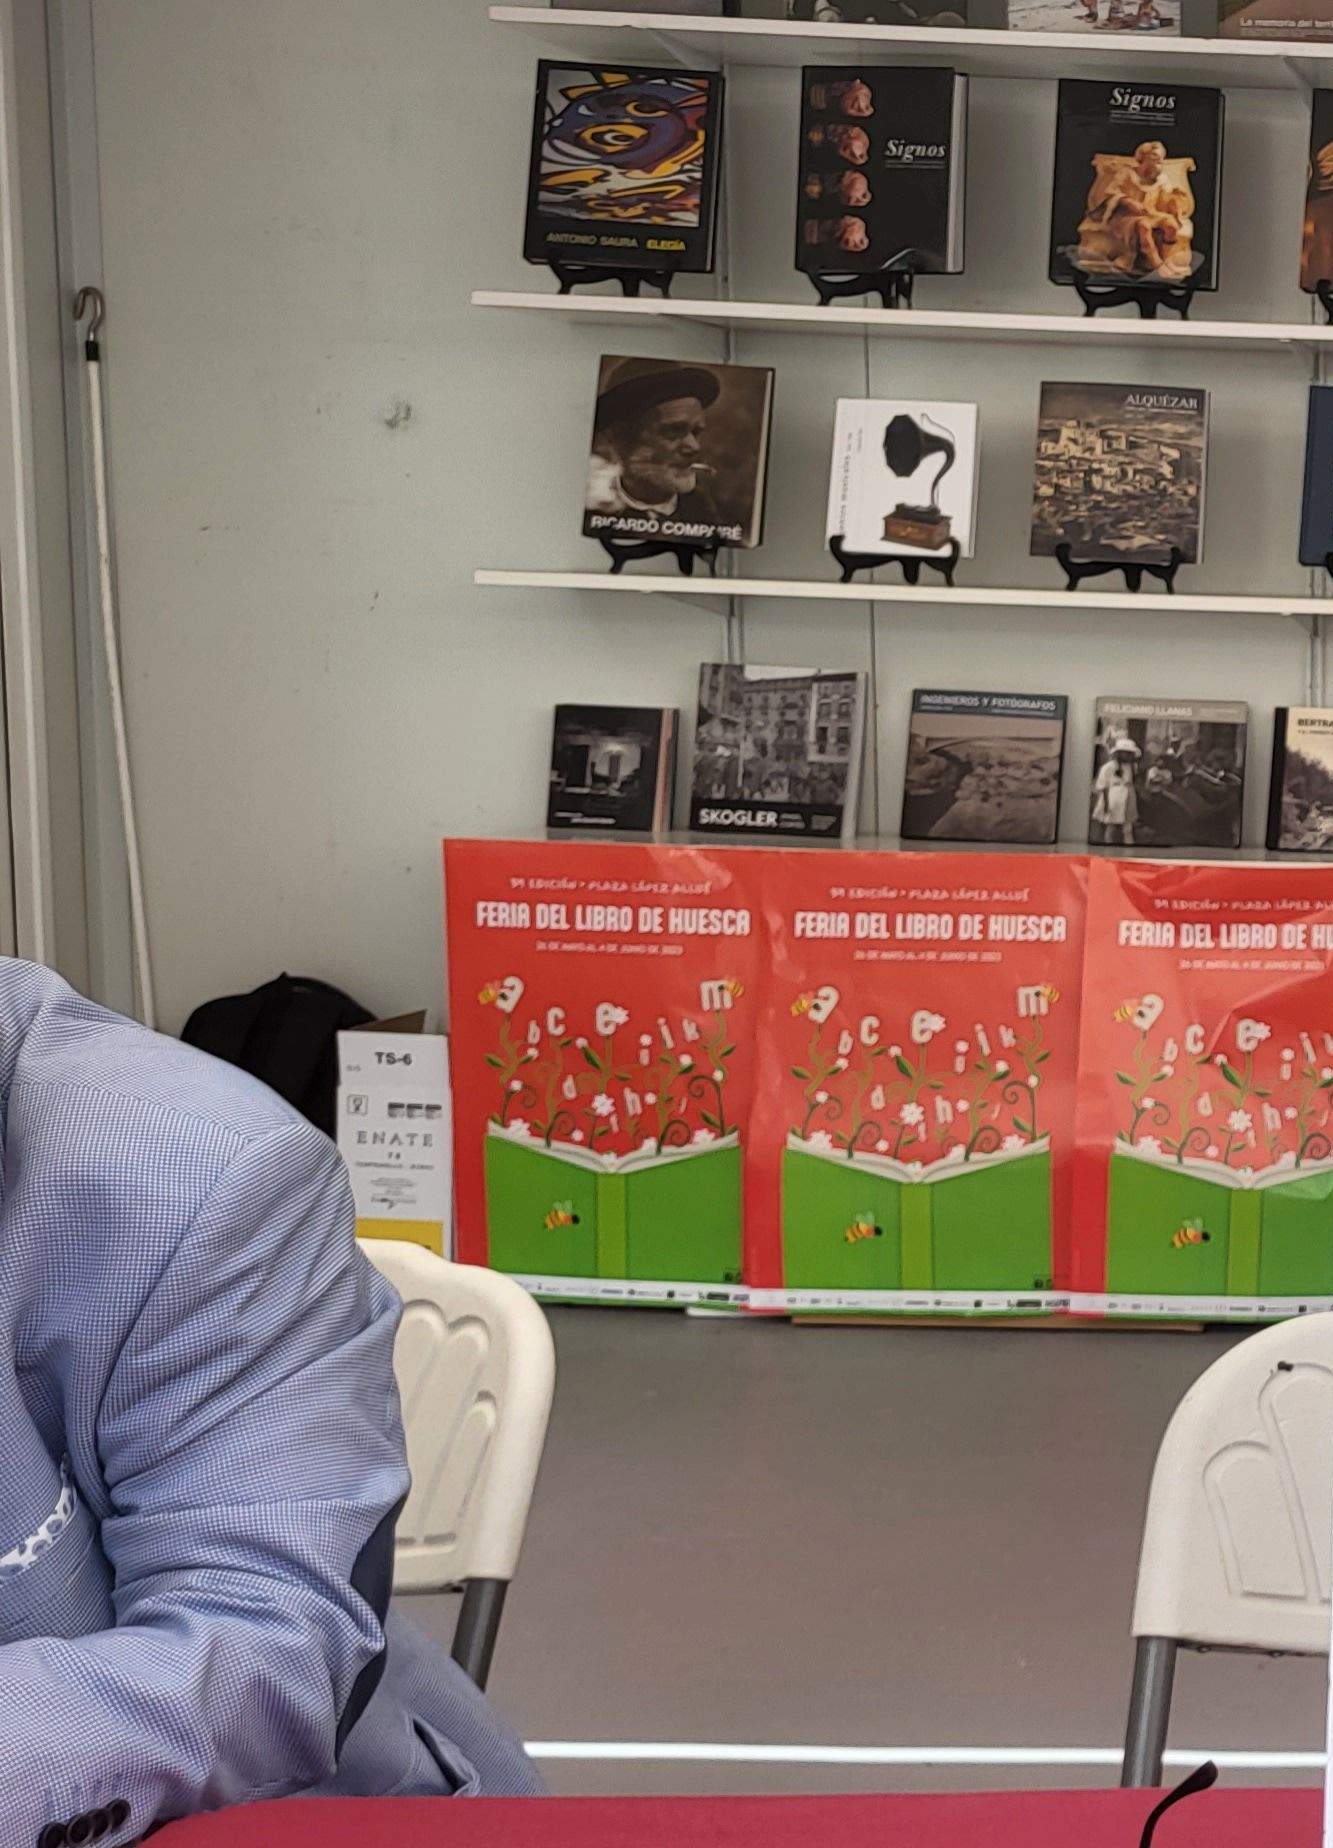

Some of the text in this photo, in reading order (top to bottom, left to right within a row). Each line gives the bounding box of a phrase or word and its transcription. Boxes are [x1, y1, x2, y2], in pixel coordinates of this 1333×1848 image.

[1109, 88, 1177, 113] Signos
[884, 139, 946, 163] Signos
[547, 232, 598, 246] ANTONIO
[600, 235, 639, 248] SAURA
[1125, 392, 1199, 410] ALQUÉZAR
[590, 514, 660, 534] RICARDO
[699, 807, 779, 829] SKOGLER
[476, 900, 751, 937] FERIA DEL LIBRO DE HUESCA
[794, 911, 1067, 943] FERIA DEL LIBRO DE HUESCA
[1118, 919, 1176, 948] FERIA
[1179, 922, 1216, 950] DEL
[1219, 922, 1278, 951] LIBRO
[1280, 923, 1308, 951] DE
[374, 1052, 413, 1067] TS-6
[356, 1130, 434, 1148] ENATE
